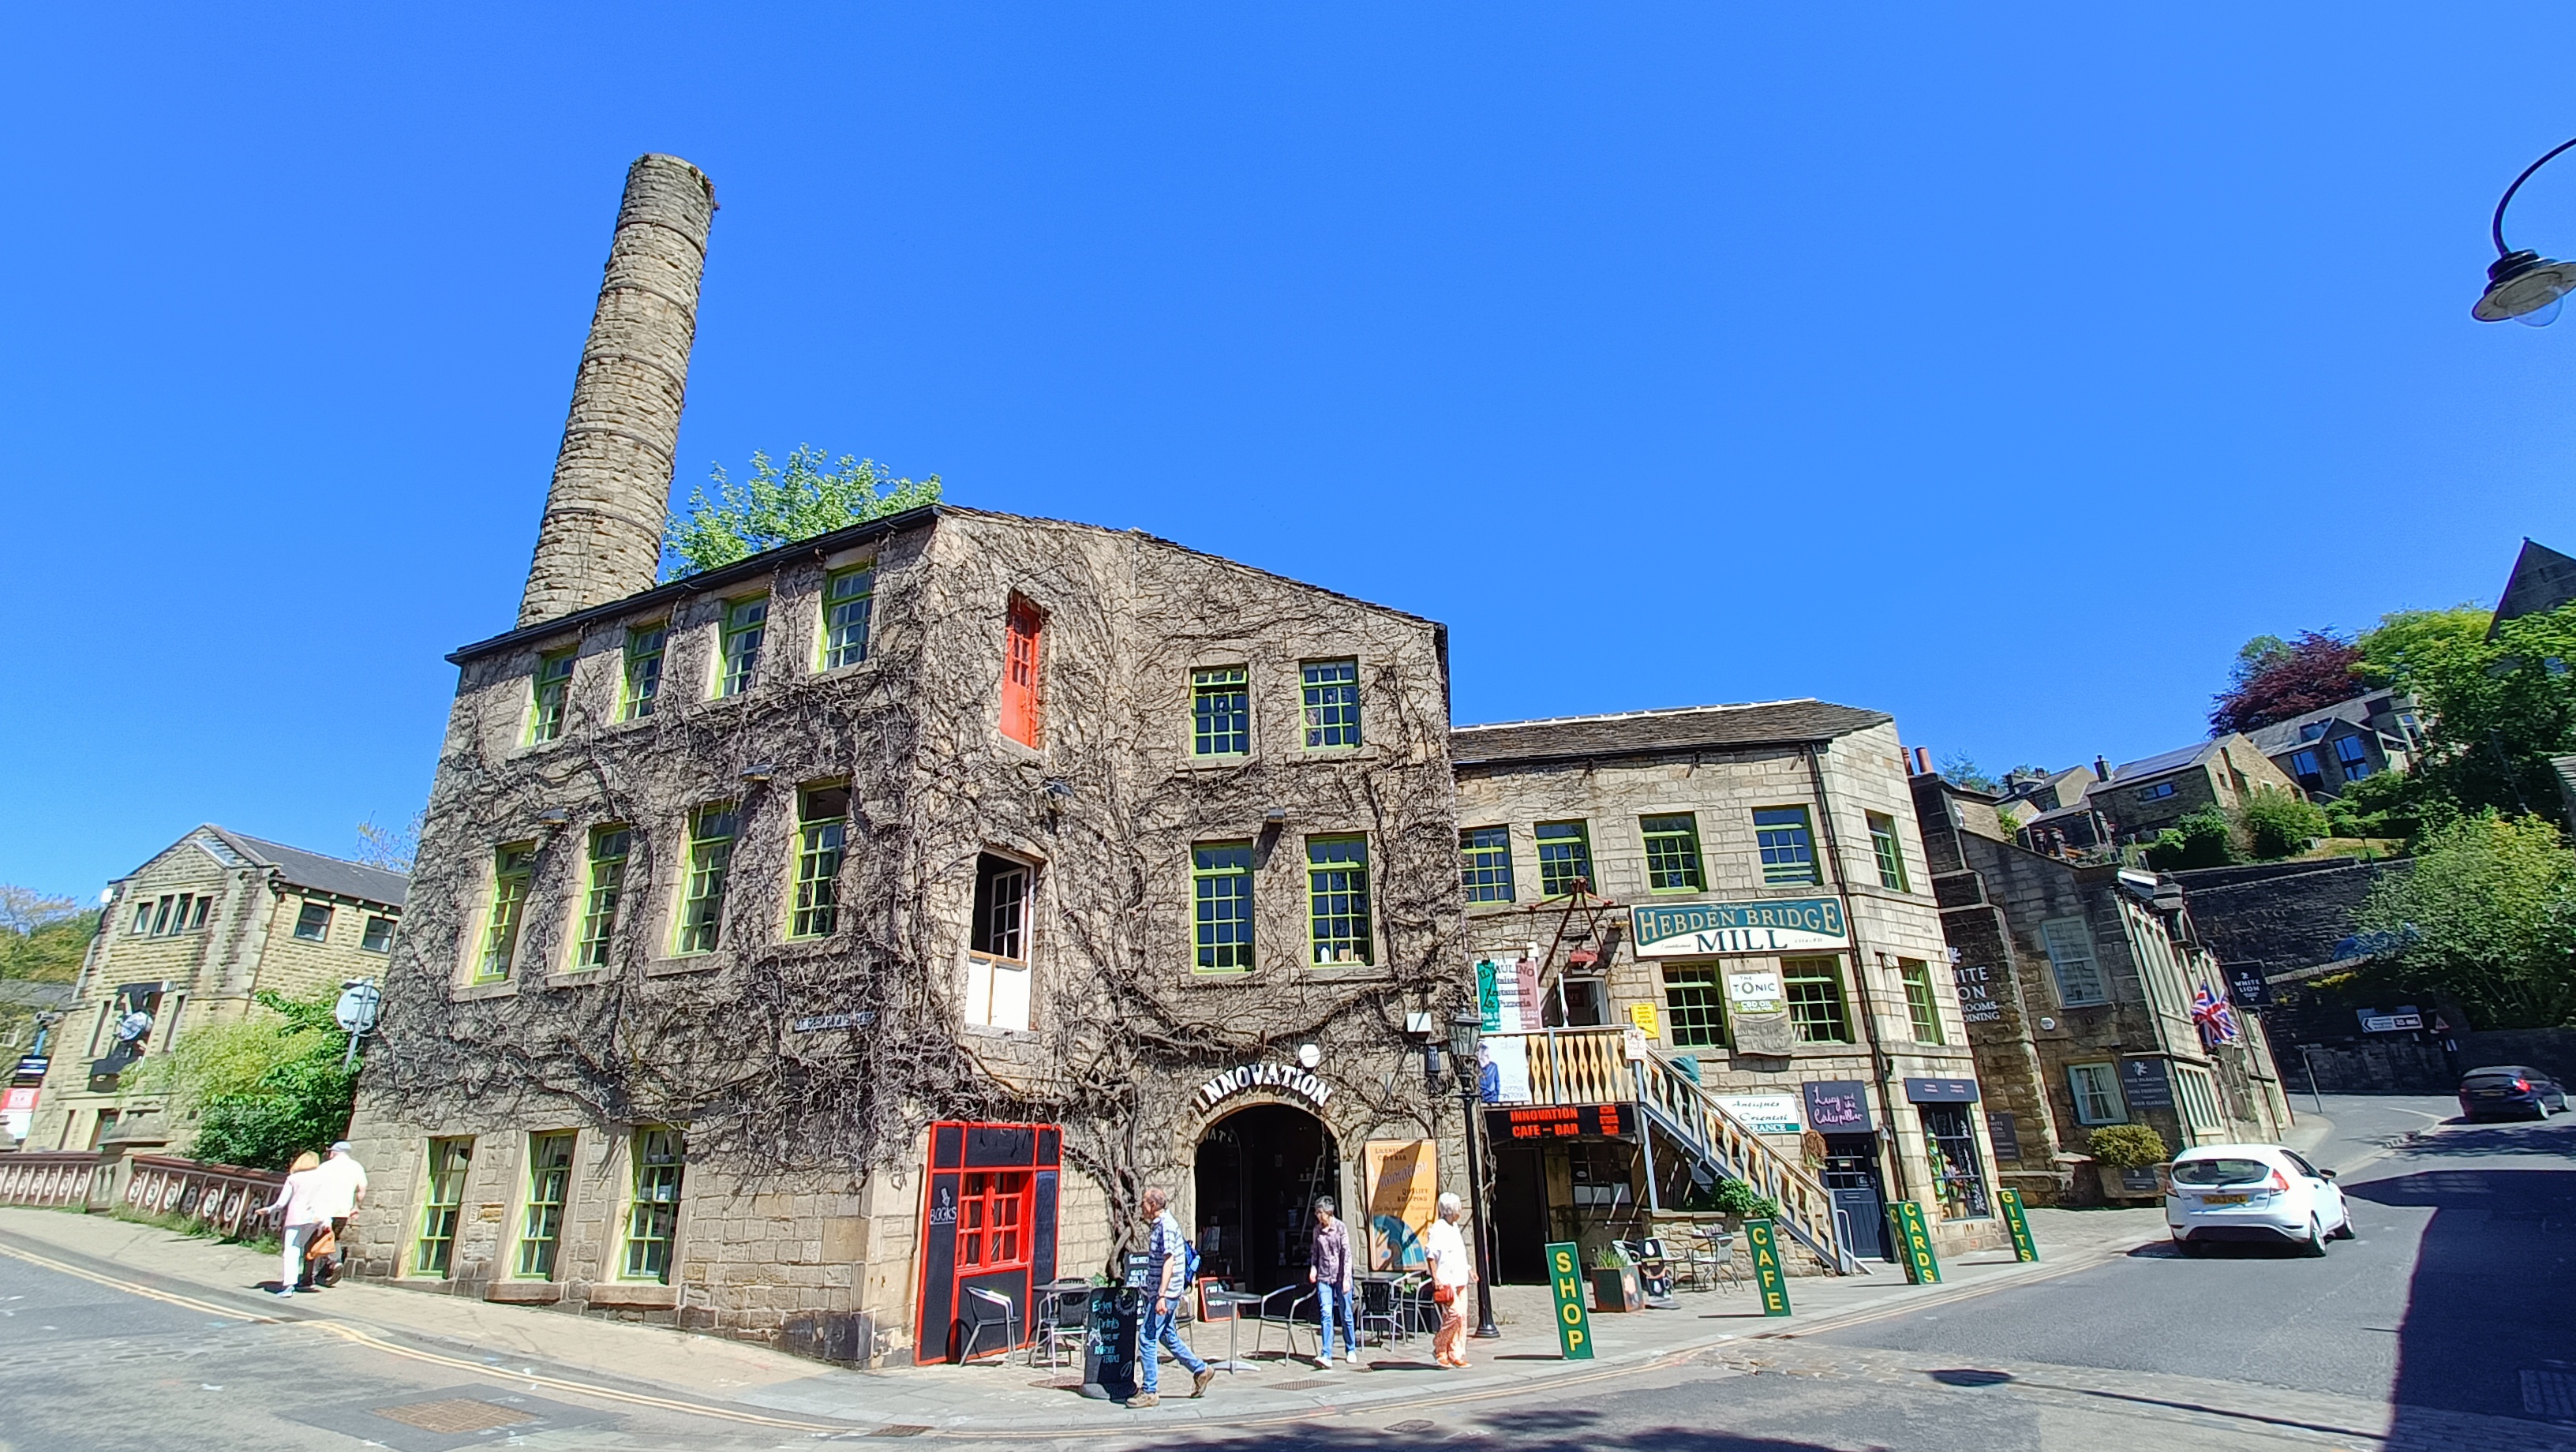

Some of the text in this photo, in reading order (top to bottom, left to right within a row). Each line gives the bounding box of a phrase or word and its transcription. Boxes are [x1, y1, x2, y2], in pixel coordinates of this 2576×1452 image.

[1638, 903, 1840, 942] HEBDEN BRIDGE
[1696, 930, 1788, 952] MILL
[1479, 969, 1490, 979] IL
[1733, 982, 1775, 994] TONIC
[1957, 986, 1986, 1001] ON
[1193, 1064, 1334, 1113] INNOVATION
[1814, 1086, 1841, 1112] Lucy
[1511, 1108, 1578, 1122] INNOVATION
[1814, 1108, 1863, 1125] Caterpillar
[1513, 1125, 1541, 1138] CAFE
[1555, 1124, 1579, 1136] BAR
[930, 1206, 957, 1223] BOOKS
[2001, 1191, 2032, 1262] GIFTS
[1890, 1209, 1915, 1279] CAFE
[1904, 1203, 1935, 1283] CARDS
[1752, 1227, 1783, 1310] CAFE
[1556, 1252, 1584, 1352] SHOP
